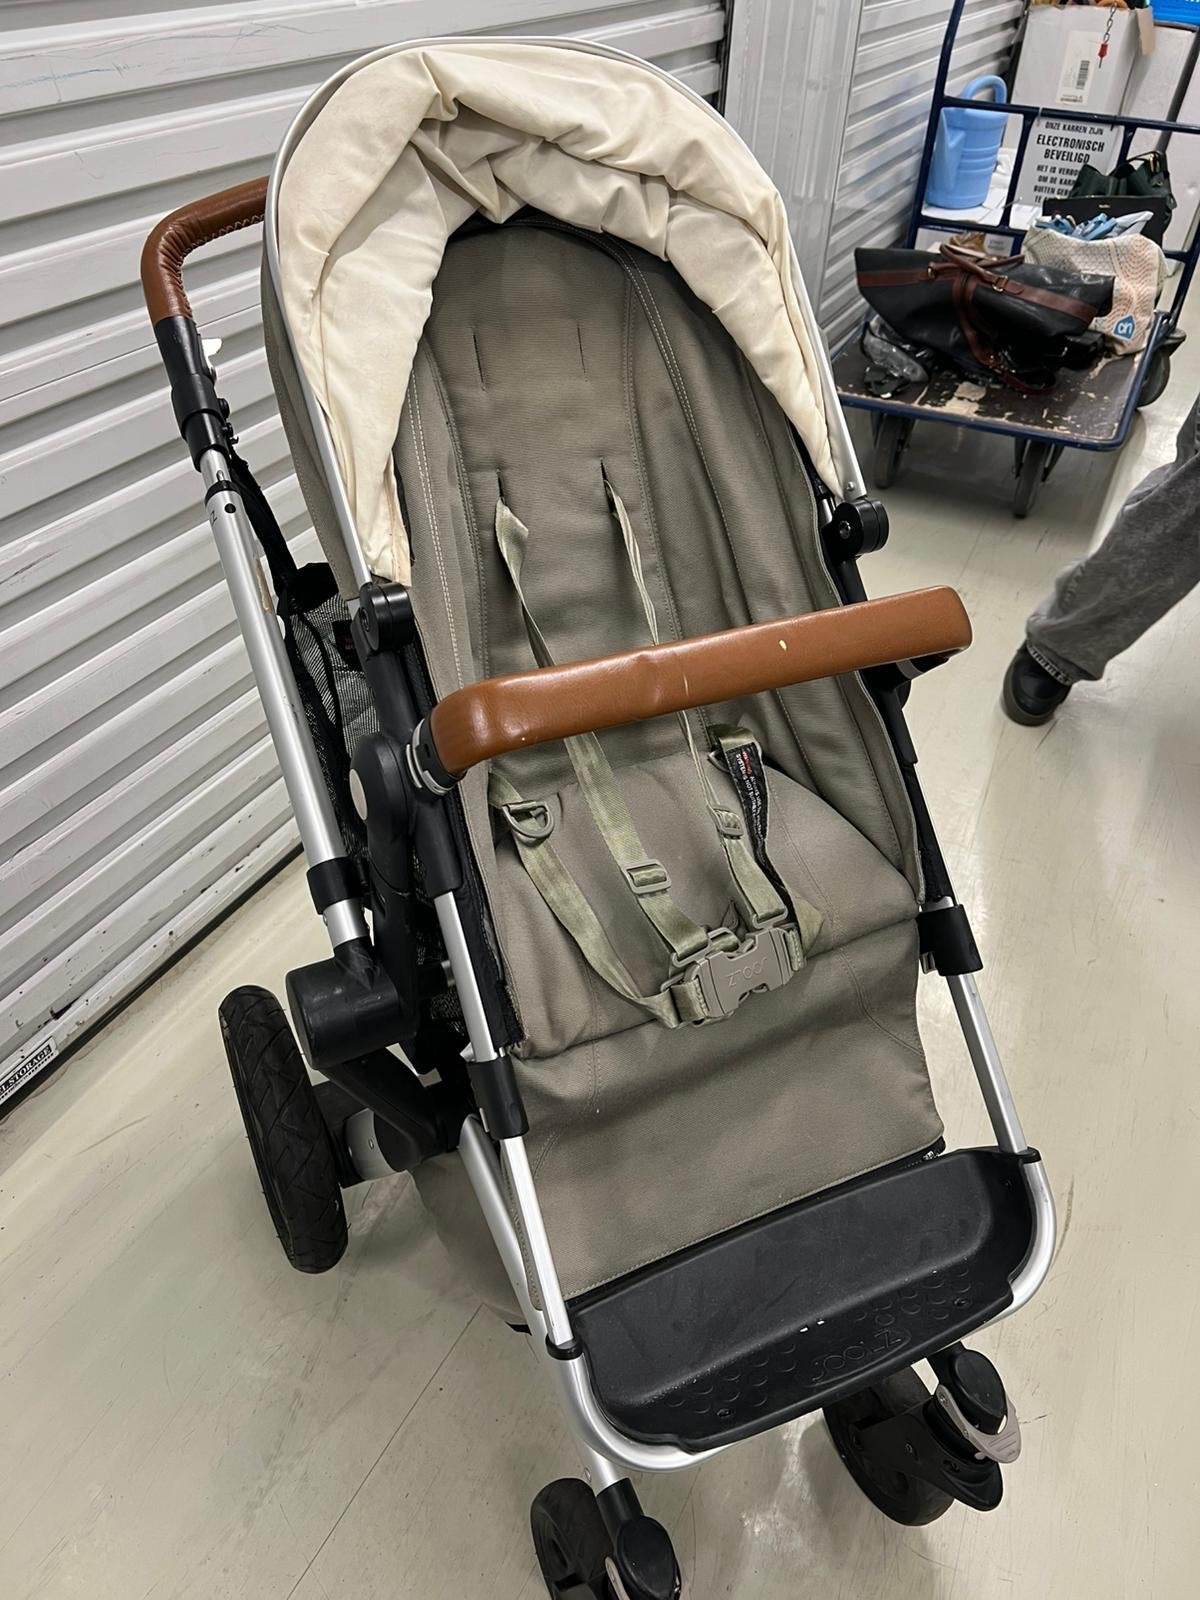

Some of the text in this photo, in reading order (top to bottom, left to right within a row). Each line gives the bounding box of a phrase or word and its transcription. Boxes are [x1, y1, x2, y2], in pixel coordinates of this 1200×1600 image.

[1045, 121, 1104, 135] ONZE KARREN ZIJN
[1036, 134, 1105, 152] ELECTRONISCH
[1044, 149, 1090, 163] BEVEILIGD
[1038, 175, 1048, 183] OM
[1033, 185, 1055, 194] BUITEN
[1034, 195, 1042, 203] TE
[8, 1046, 51, 1086] STORAGE
